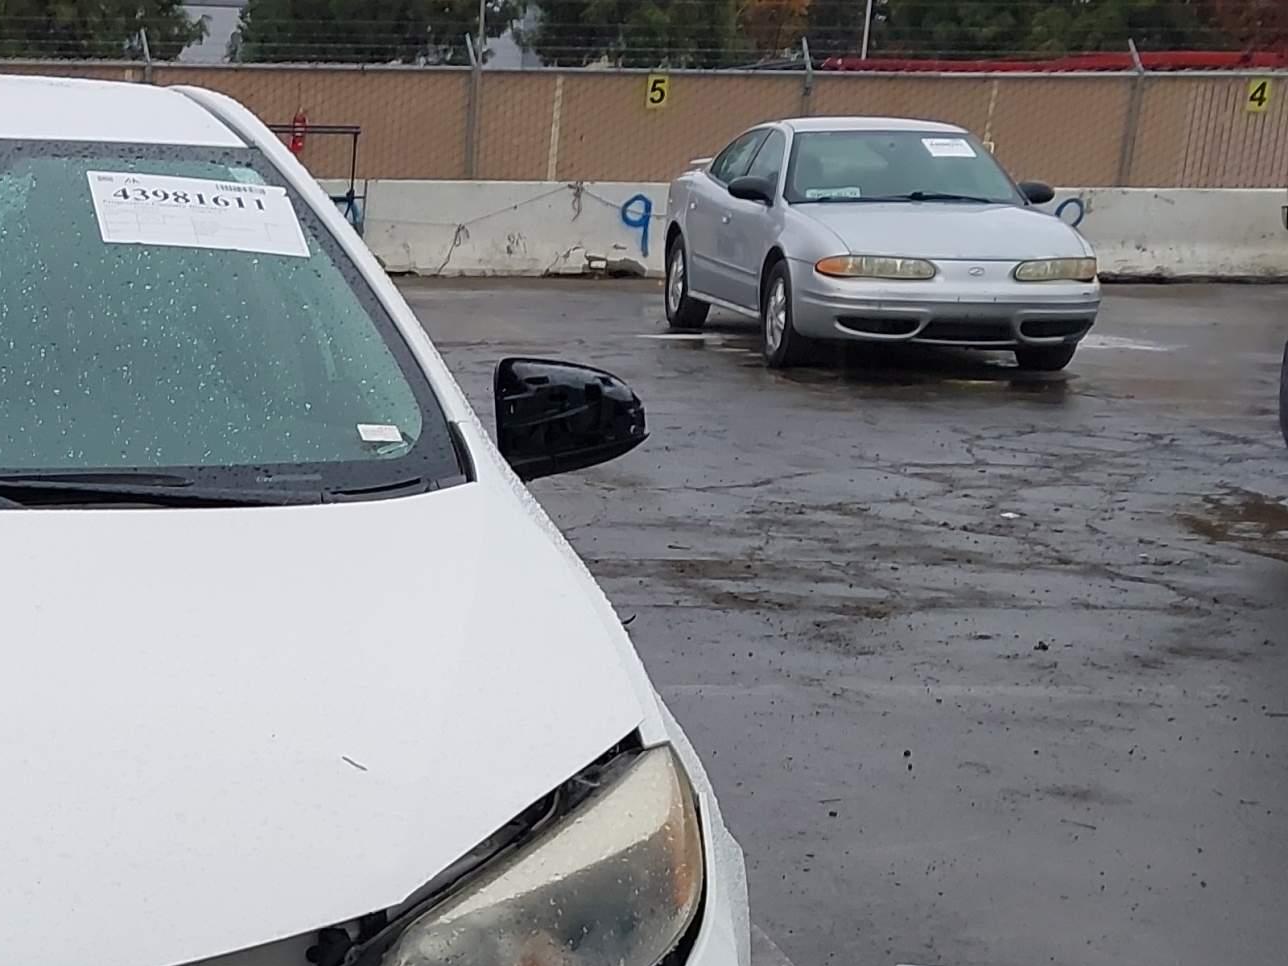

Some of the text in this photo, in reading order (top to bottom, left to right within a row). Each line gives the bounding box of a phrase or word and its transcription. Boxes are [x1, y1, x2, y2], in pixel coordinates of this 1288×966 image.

[649, 79, 666, 103] 5
[1250, 81, 1267, 106] 4
[112, 187, 266, 211] 43981611
[621, 193, 653, 258] 9
